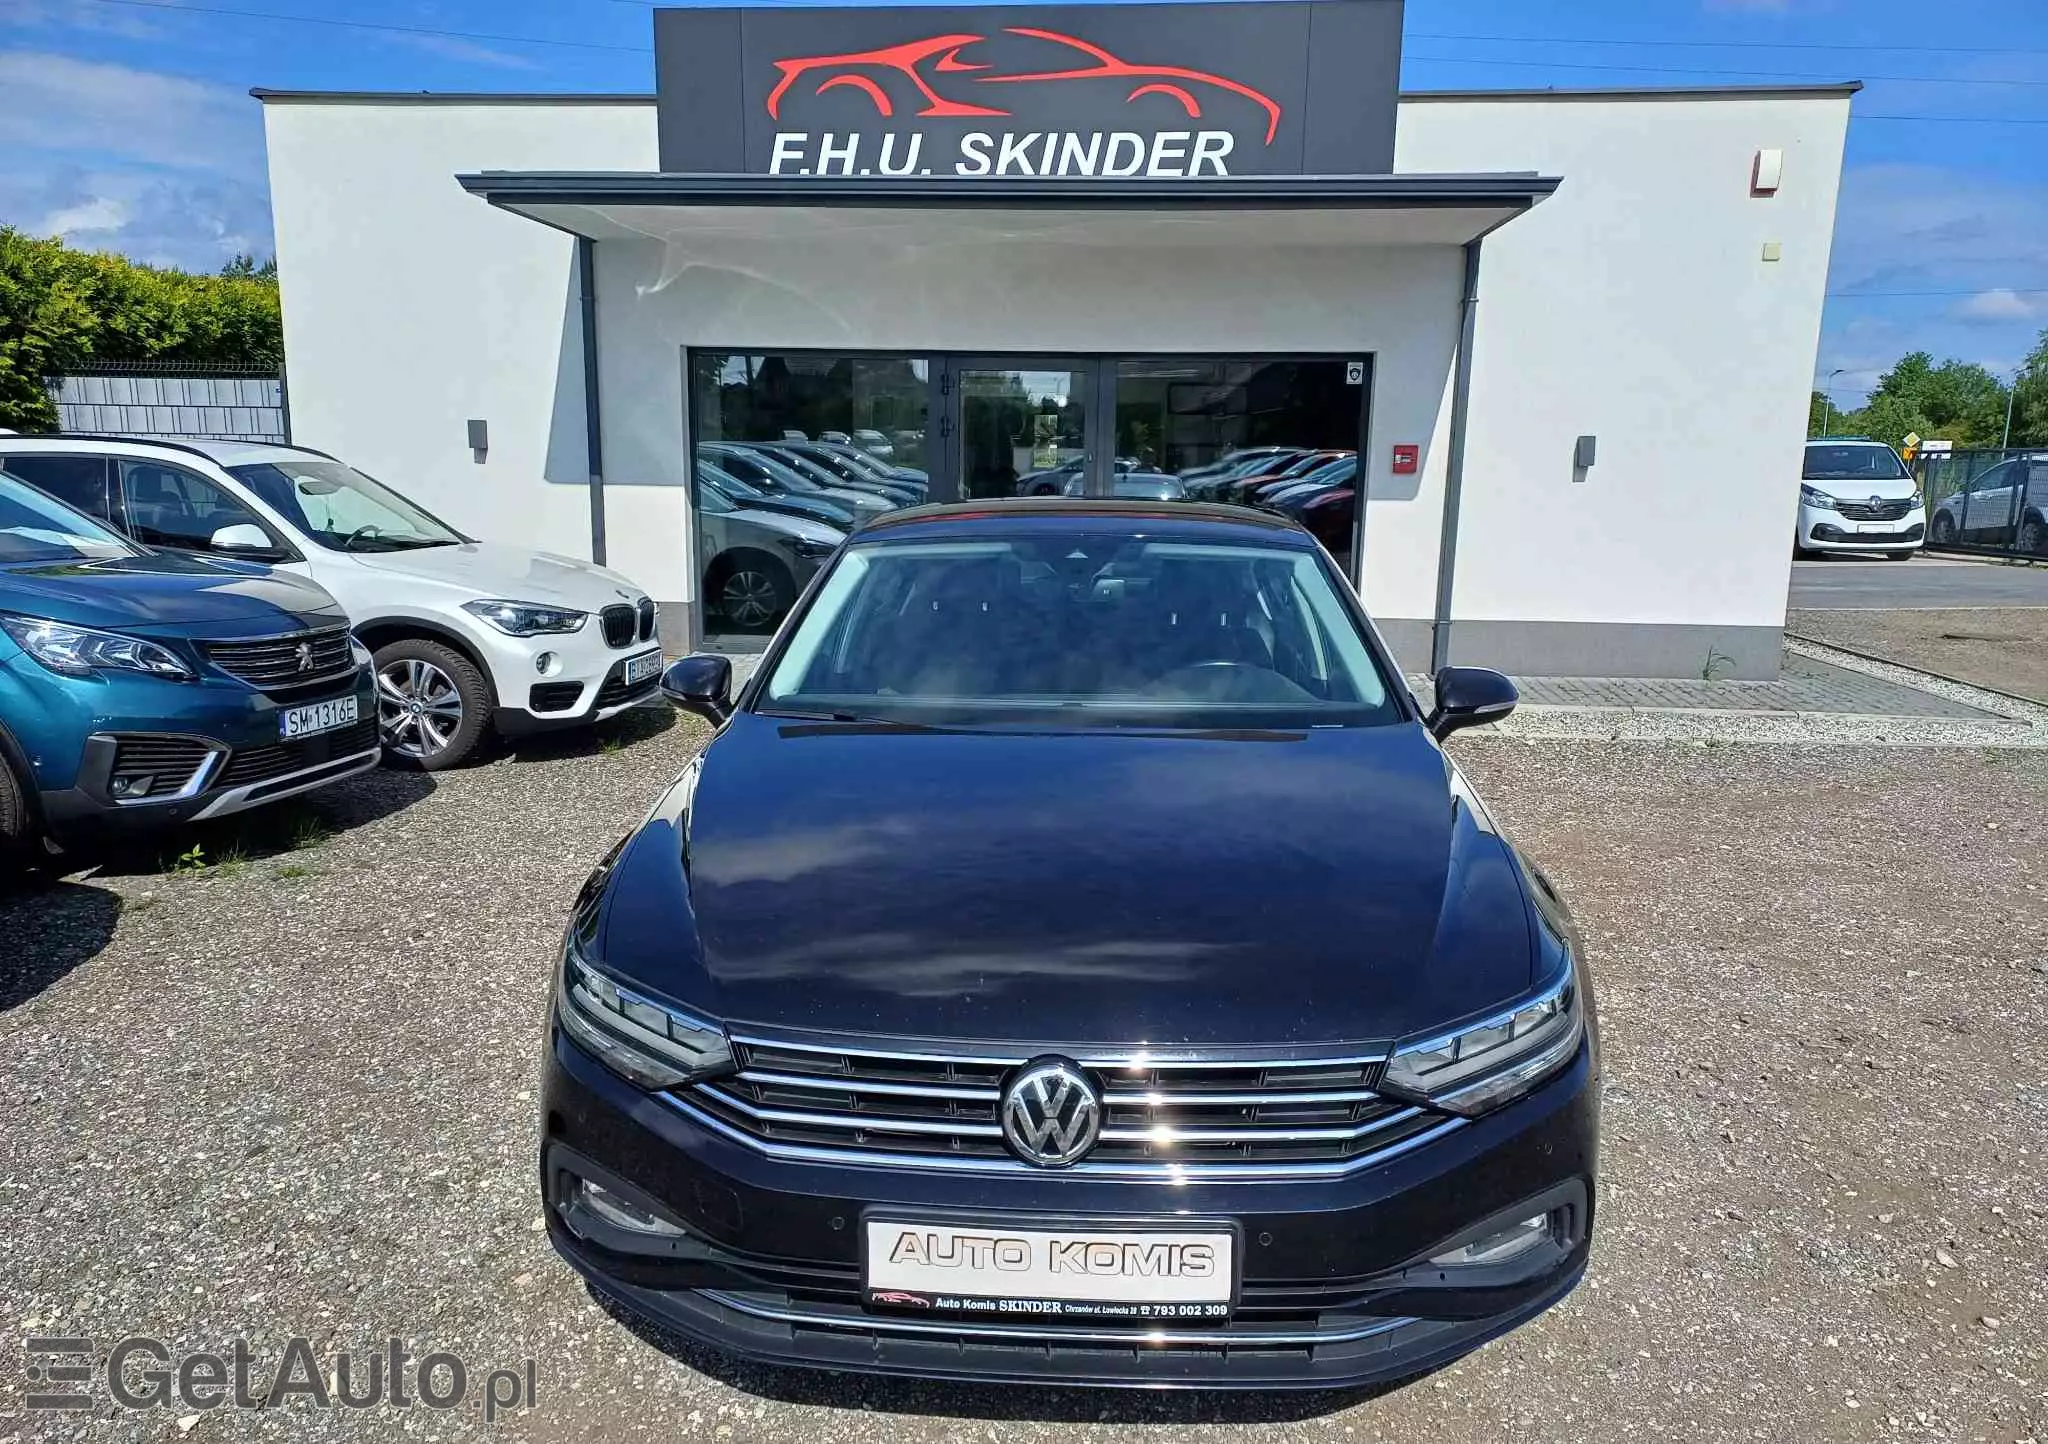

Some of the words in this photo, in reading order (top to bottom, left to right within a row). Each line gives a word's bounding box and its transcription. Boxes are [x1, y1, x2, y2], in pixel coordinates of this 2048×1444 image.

[769, 131, 932, 175] F.H.U.
[955, 130, 1235, 176] SKINDER
[288, 709, 309, 733] SM
[314, 699, 354, 727] 1316E
[889, 1231, 1032, 1271] AUTO
[1049, 1240, 1215, 1277] KOMIS
[935, 1297, 960, 1309] Auto
[963, 1299, 996, 1311] Komis
[999, 1300, 1062, 1313] SKINDER
[1154, 1305, 1176, 1316] 793
[1179, 1305, 1202, 1316] 002
[1205, 1305, 1228, 1316] 309
